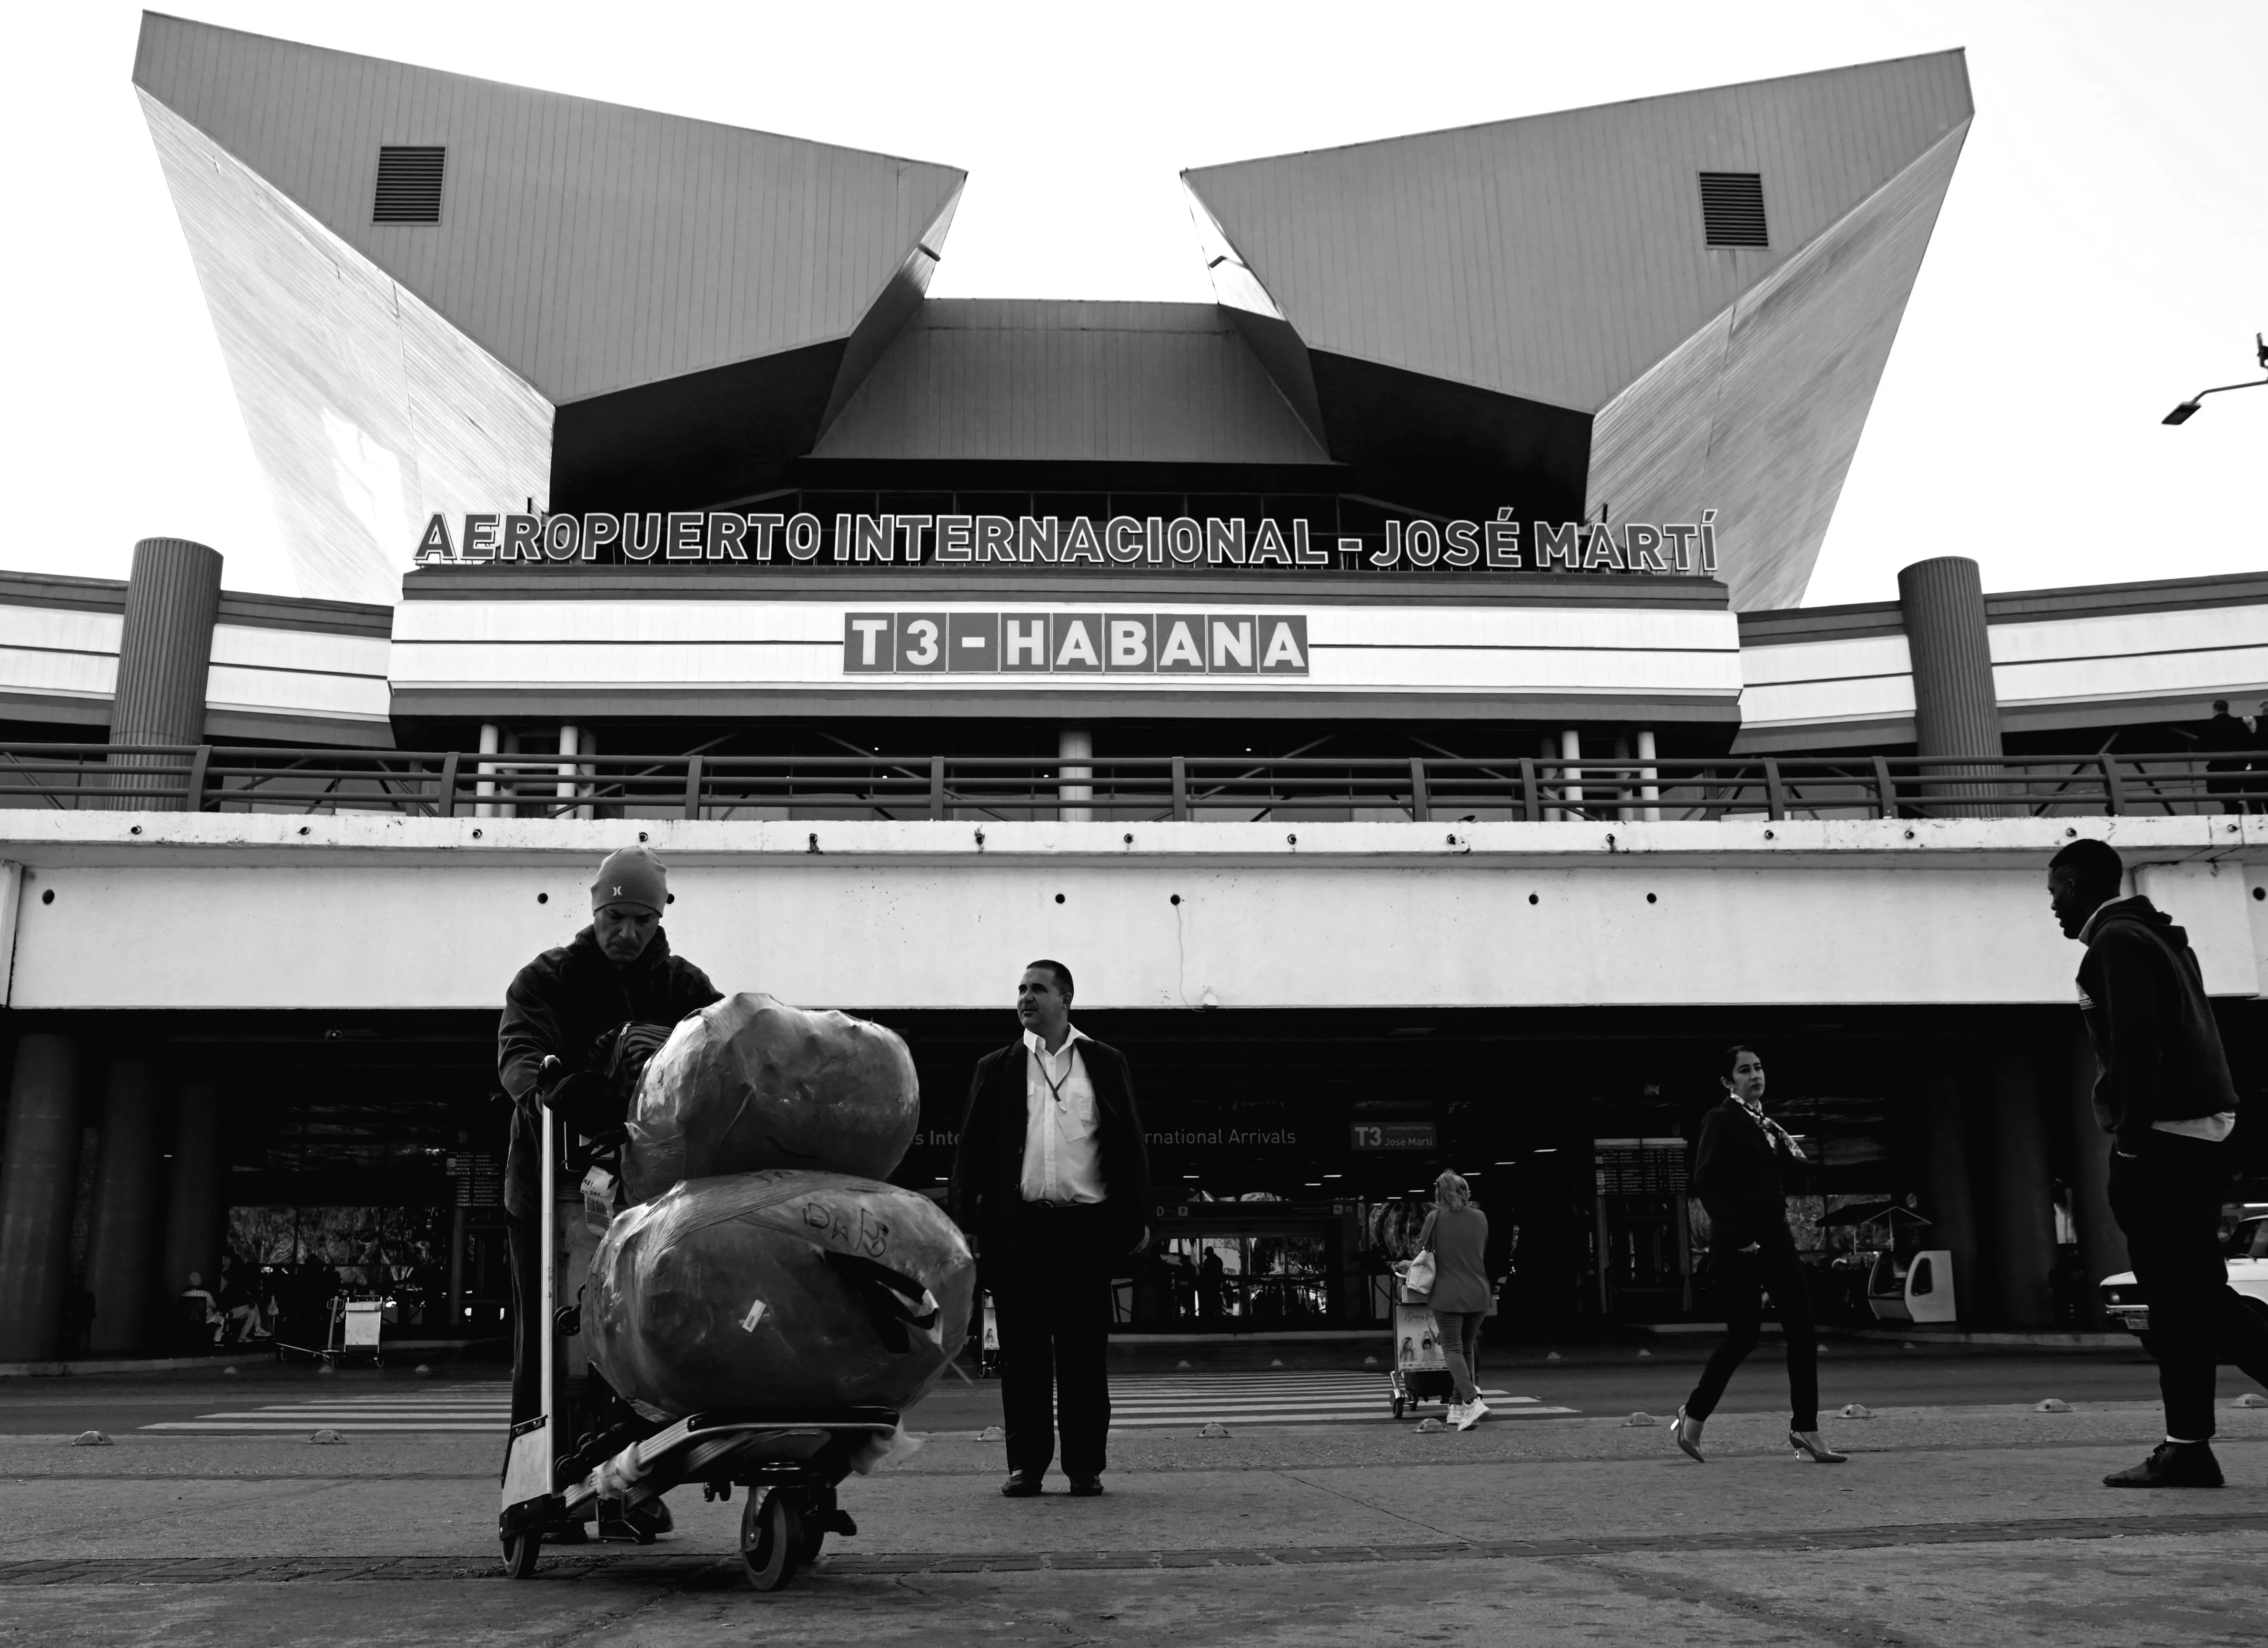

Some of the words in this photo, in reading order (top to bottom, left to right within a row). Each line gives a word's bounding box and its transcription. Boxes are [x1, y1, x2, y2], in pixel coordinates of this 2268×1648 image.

[413, 512, 821, 561] AEROPUERTO
[834, 514, 1328, 565] INTERNACIONAL
[1370, 506, 1522, 568] JOSÉ
[1534, 509, 1717, 571] MARTÍ
[1229, 1129, 1296, 1144] Arrivals
[1354, 1126, 1381, 1146] T3
[1384, 1136, 1406, 1146] José
[1408, 1136, 1432, 1146] Martí
